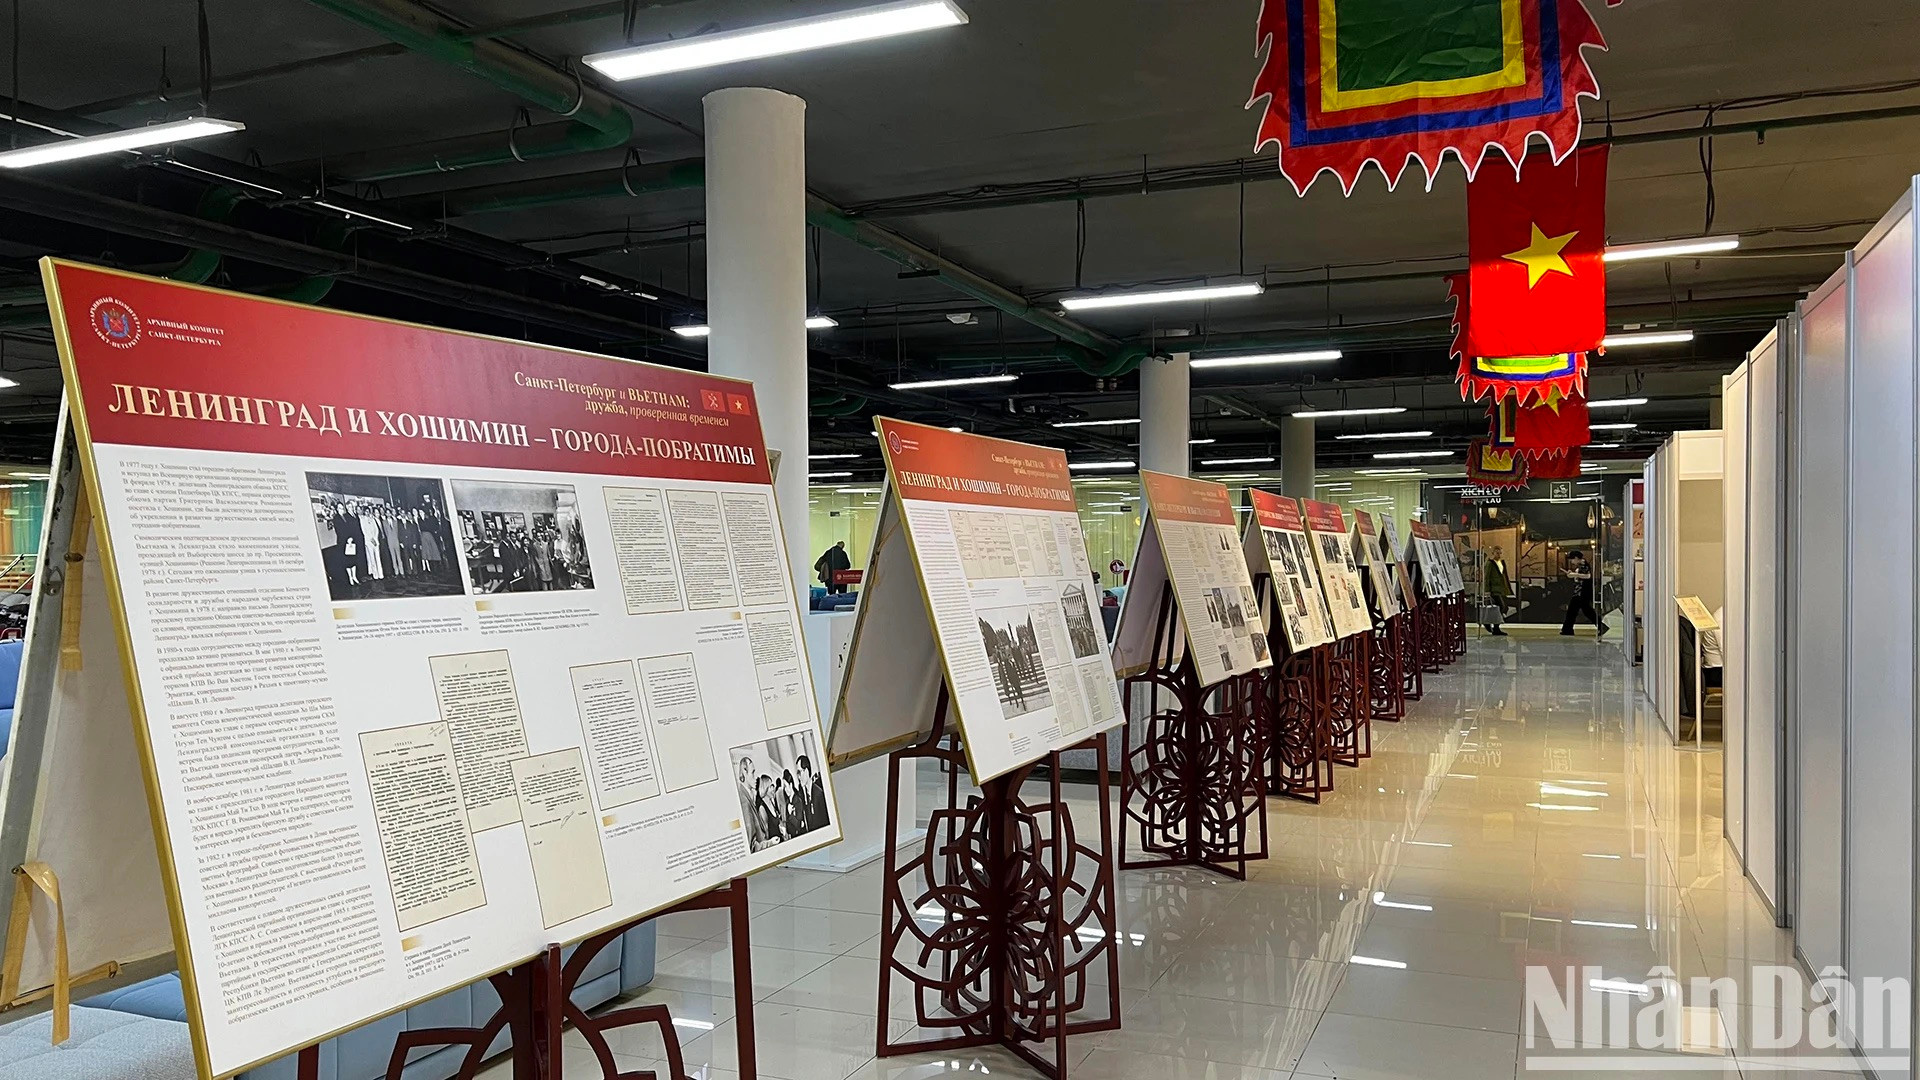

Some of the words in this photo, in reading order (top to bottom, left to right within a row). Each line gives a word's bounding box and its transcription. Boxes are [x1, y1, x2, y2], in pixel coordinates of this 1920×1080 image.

[147, 318, 188, 331] АРХИВНЫЙ
[189, 324, 225, 336] КОМИТЕТ
[148, 330, 222, 347] САНКТ-ПЕТЕРБУРГА
[514, 371, 616, 399] Санкт-Петербург
[619, 390, 626, 400] и
[627, 387, 691, 409] ВЬЕТНАМ:
[108, 383, 342, 438] ЛЕНИНГРАД
[347, 406, 371, 434] И
[375, 410, 530, 448] ХОШИМИН
[550, 427, 757, 466] ГОРОДА-ПОБРАТИМЫ
[584, 399, 628, 417] дружба,
[629, 405, 688, 423] проверенная
[688, 415, 730, 428] временем
[900, 470, 953, 491] ЛЕНИНГРАД
[954, 478, 960, 491] И
[961, 477, 1002, 495] ХОШИМИН
[1006, 484, 1071, 502] ГОРОДА-ПОБРАТИМЫ
